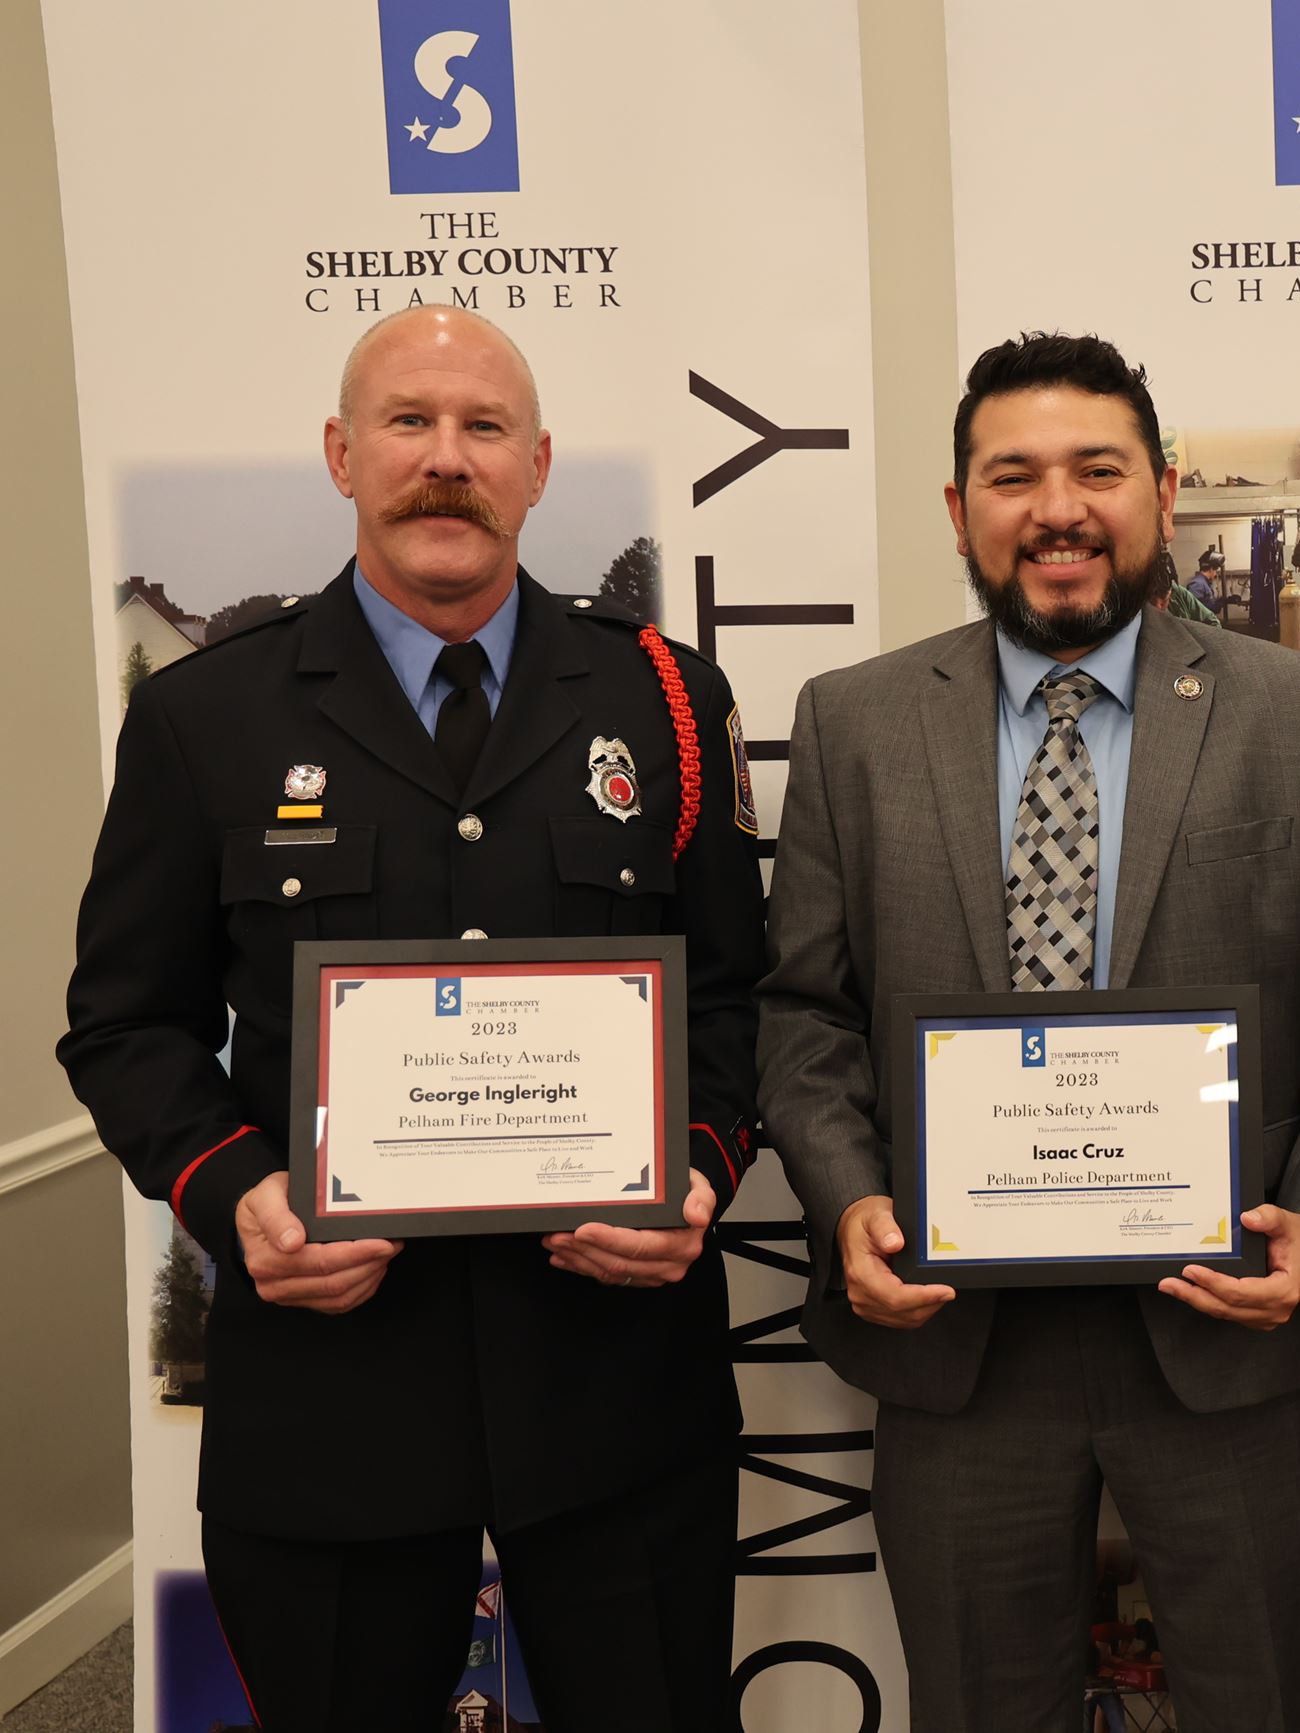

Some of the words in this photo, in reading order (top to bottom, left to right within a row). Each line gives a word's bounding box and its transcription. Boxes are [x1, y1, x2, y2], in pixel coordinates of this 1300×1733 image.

[419, 211, 499, 240] THE
[305, 249, 449, 279] SHELBY
[457, 246, 619, 276] COUNTY
[304, 283, 621, 313] CHAMBER
[471, 1021, 517, 1036] 2023
[403, 1052, 454, 1067] Public
[458, 1050, 513, 1068] Safety
[516, 1049, 580, 1064] Awards
[1050, 1058, 1120, 1066] CHAMBER
[1055, 1072, 1098, 1087] 2023
[408, 1087, 480, 1106] George
[485, 1083, 577, 1105] Ingleright
[993, 1103, 1041, 1118] Public
[1044, 1102, 1095, 1119] Safety
[1098, 1100, 1159, 1115] Awards
[399, 1114, 455, 1128] Pelham
[460, 1113, 492, 1127] Fire
[495, 1112, 589, 1128] Department
[1033, 1144, 1078, 1160] Isaac
[1082, 1142, 1125, 1159] Cruz
[986, 1172, 1037, 1186] Pelham
[1042, 1171, 1083, 1184] Police
[1087, 1170, 1171, 1186] Department
